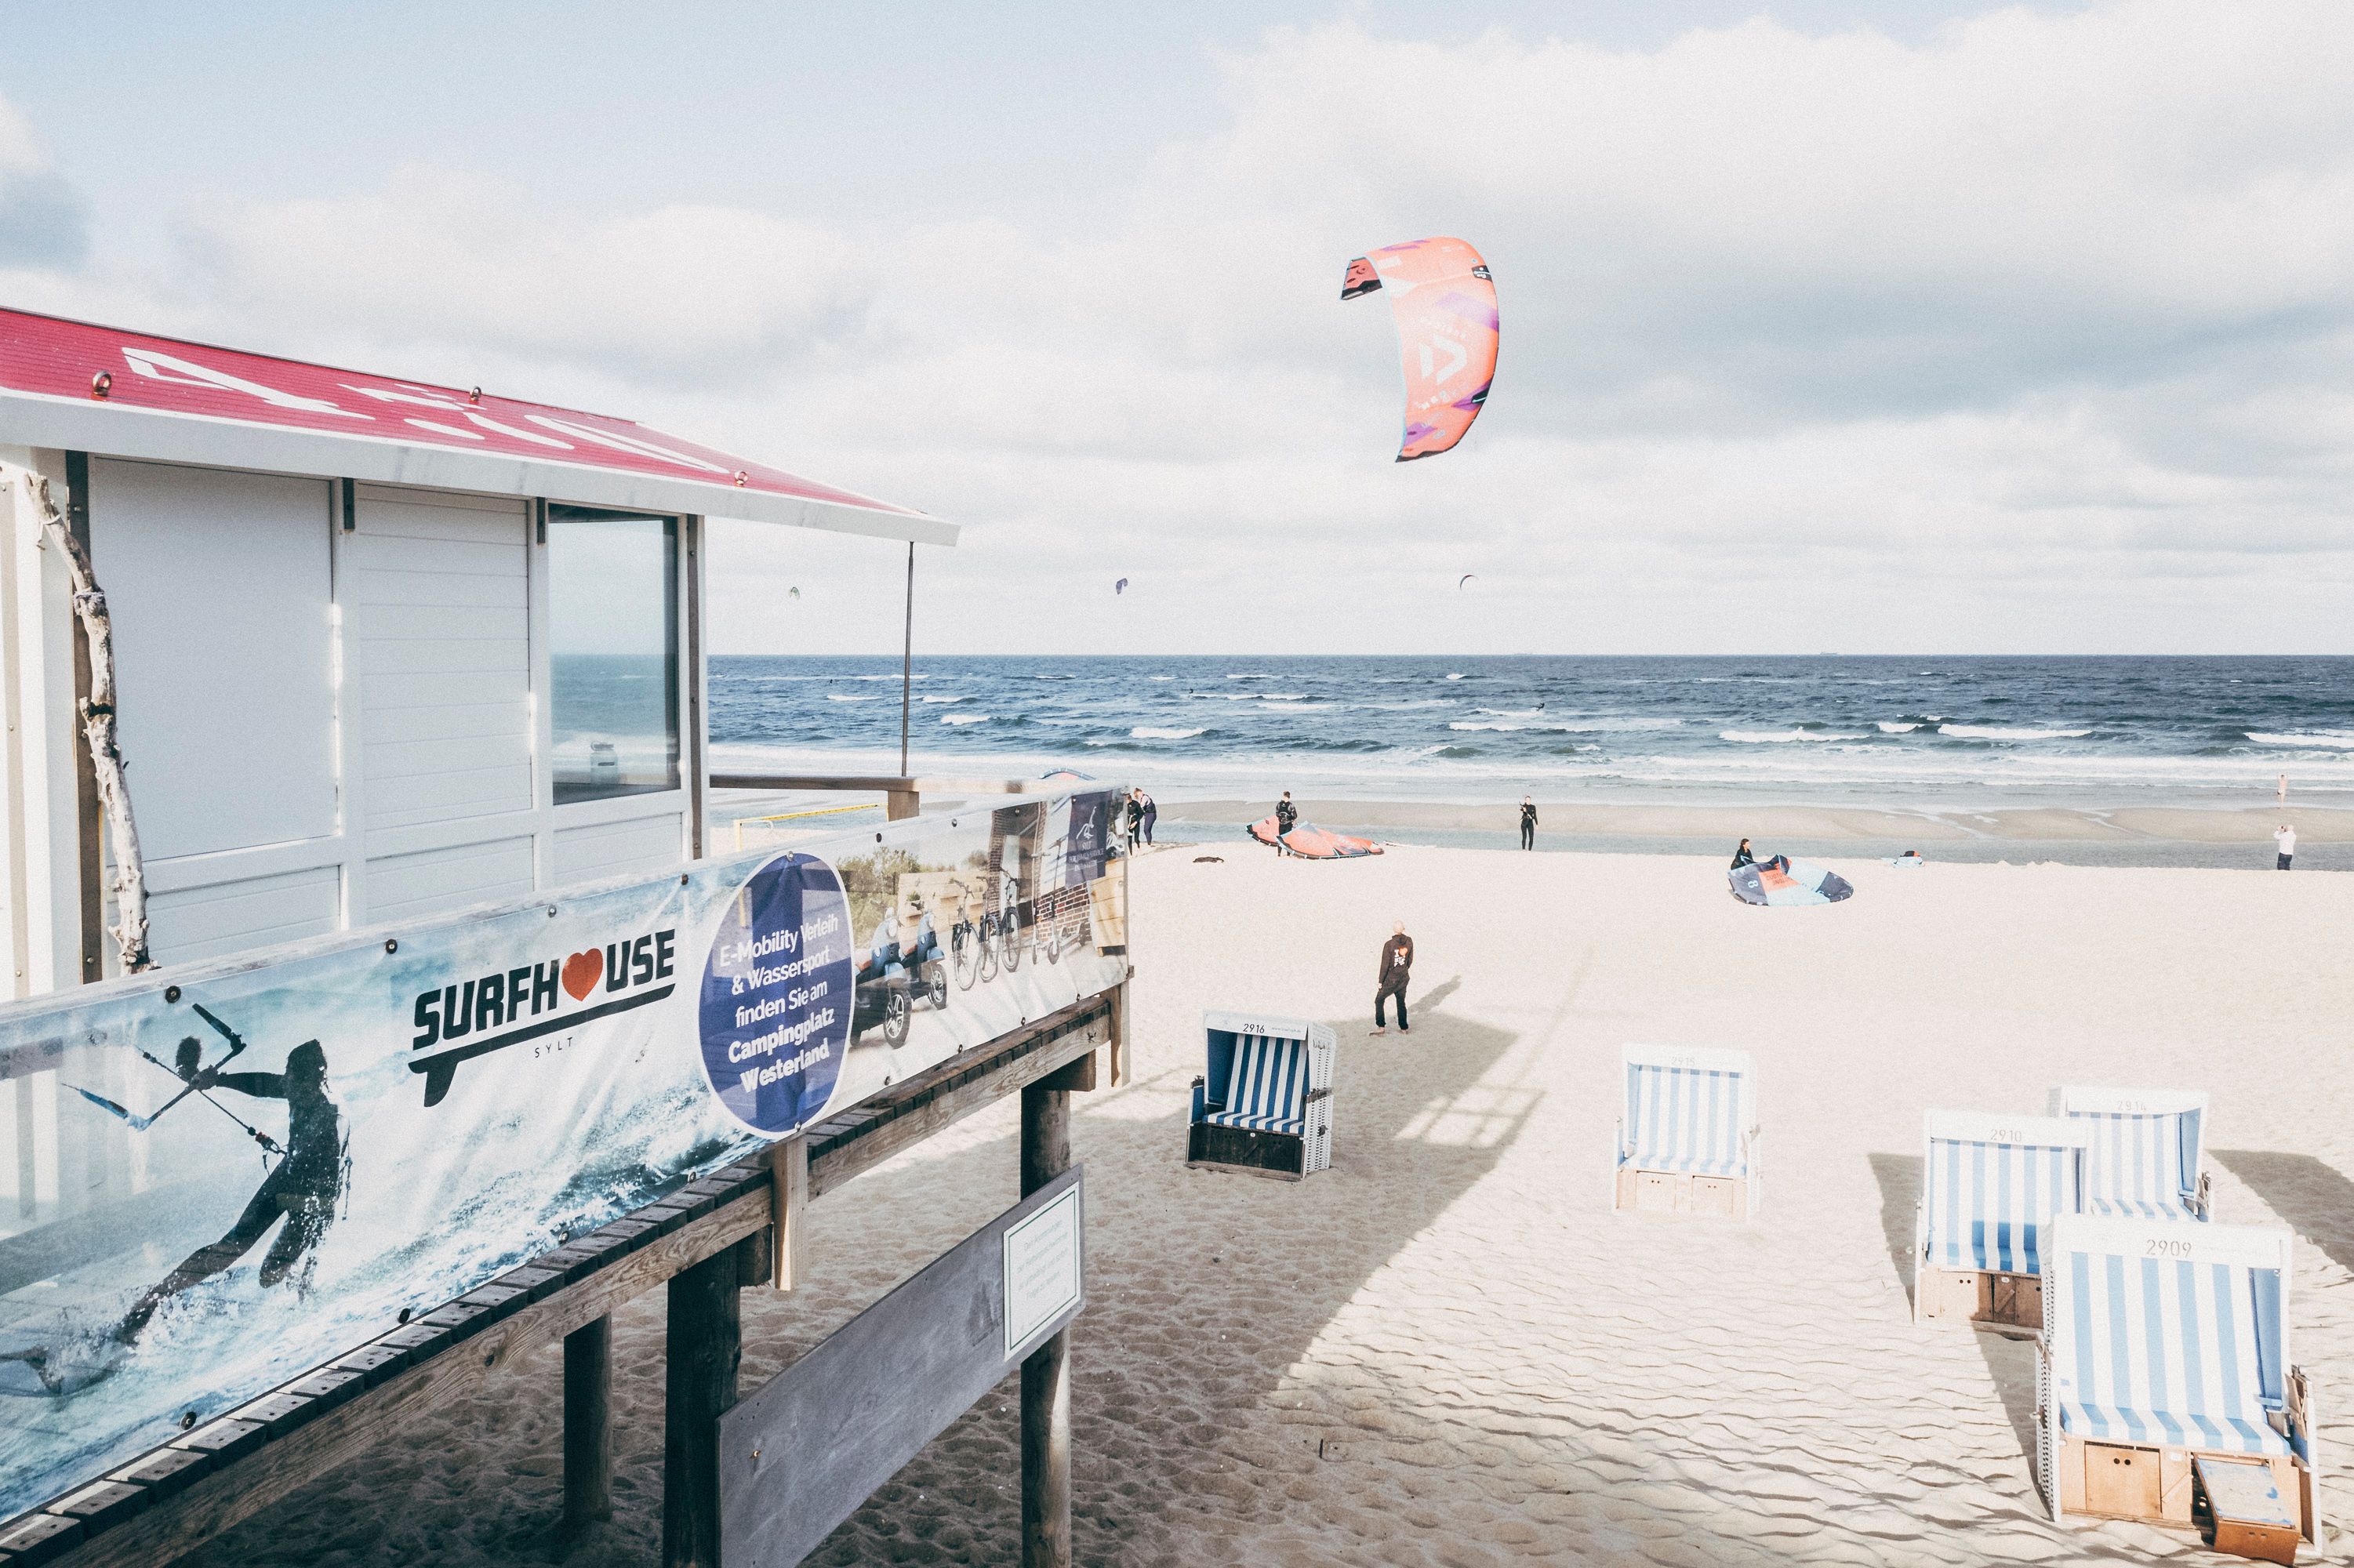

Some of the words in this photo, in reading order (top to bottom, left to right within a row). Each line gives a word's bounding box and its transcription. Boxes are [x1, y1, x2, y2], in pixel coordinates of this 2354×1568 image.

[720, 929, 797, 967] E-Mobility
[801, 915, 838, 946] Verleih
[732, 977, 744, 996] &
[748, 947, 830, 989] Wassersport
[736, 999, 784, 1028] finden
[789, 990, 808, 1011] Sie
[810, 982, 828, 1002] am
[535, 1036, 574, 1058] SYLT
[728, 1007, 835, 1064] Campingplatz
[1243, 1023, 1265, 1034] 2916
[740, 1038, 830, 1094] Westerland
[1990, 1128, 2022, 1142] 2910
[2146, 1239, 2192, 1258] 2909
